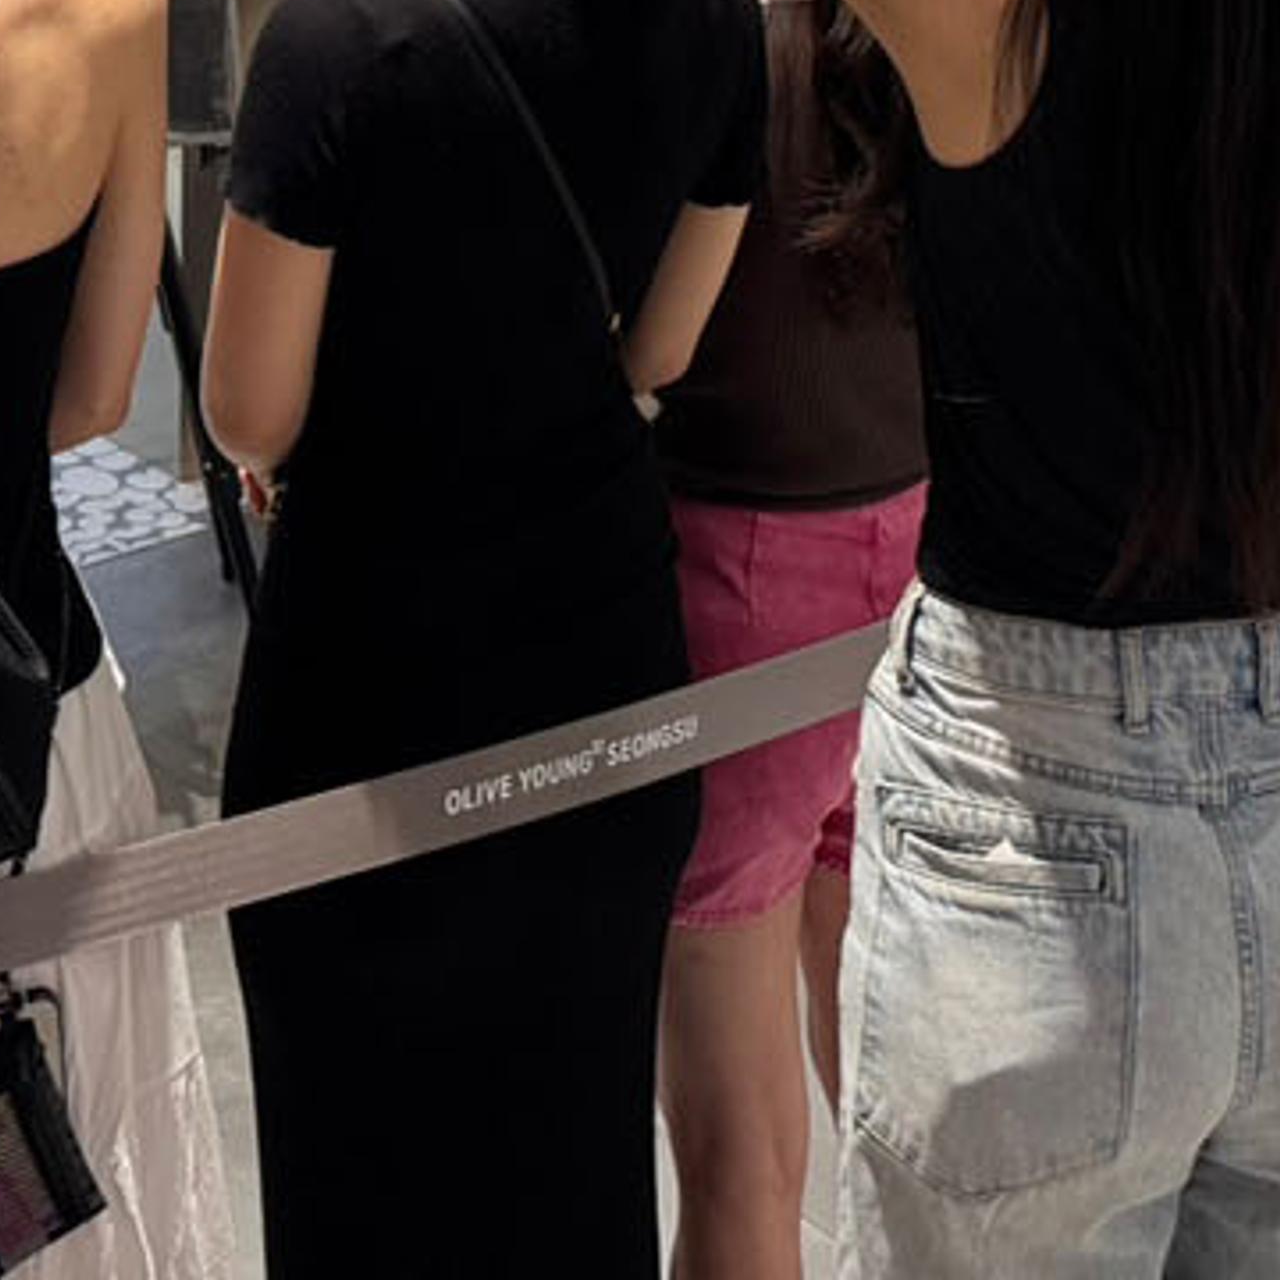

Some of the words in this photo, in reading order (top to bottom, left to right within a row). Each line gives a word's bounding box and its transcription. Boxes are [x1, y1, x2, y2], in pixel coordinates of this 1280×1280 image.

[444, 773, 514, 816] OLIVE
[519, 749, 594, 793] YOUNG
[607, 715, 699, 767] SEONGSU
